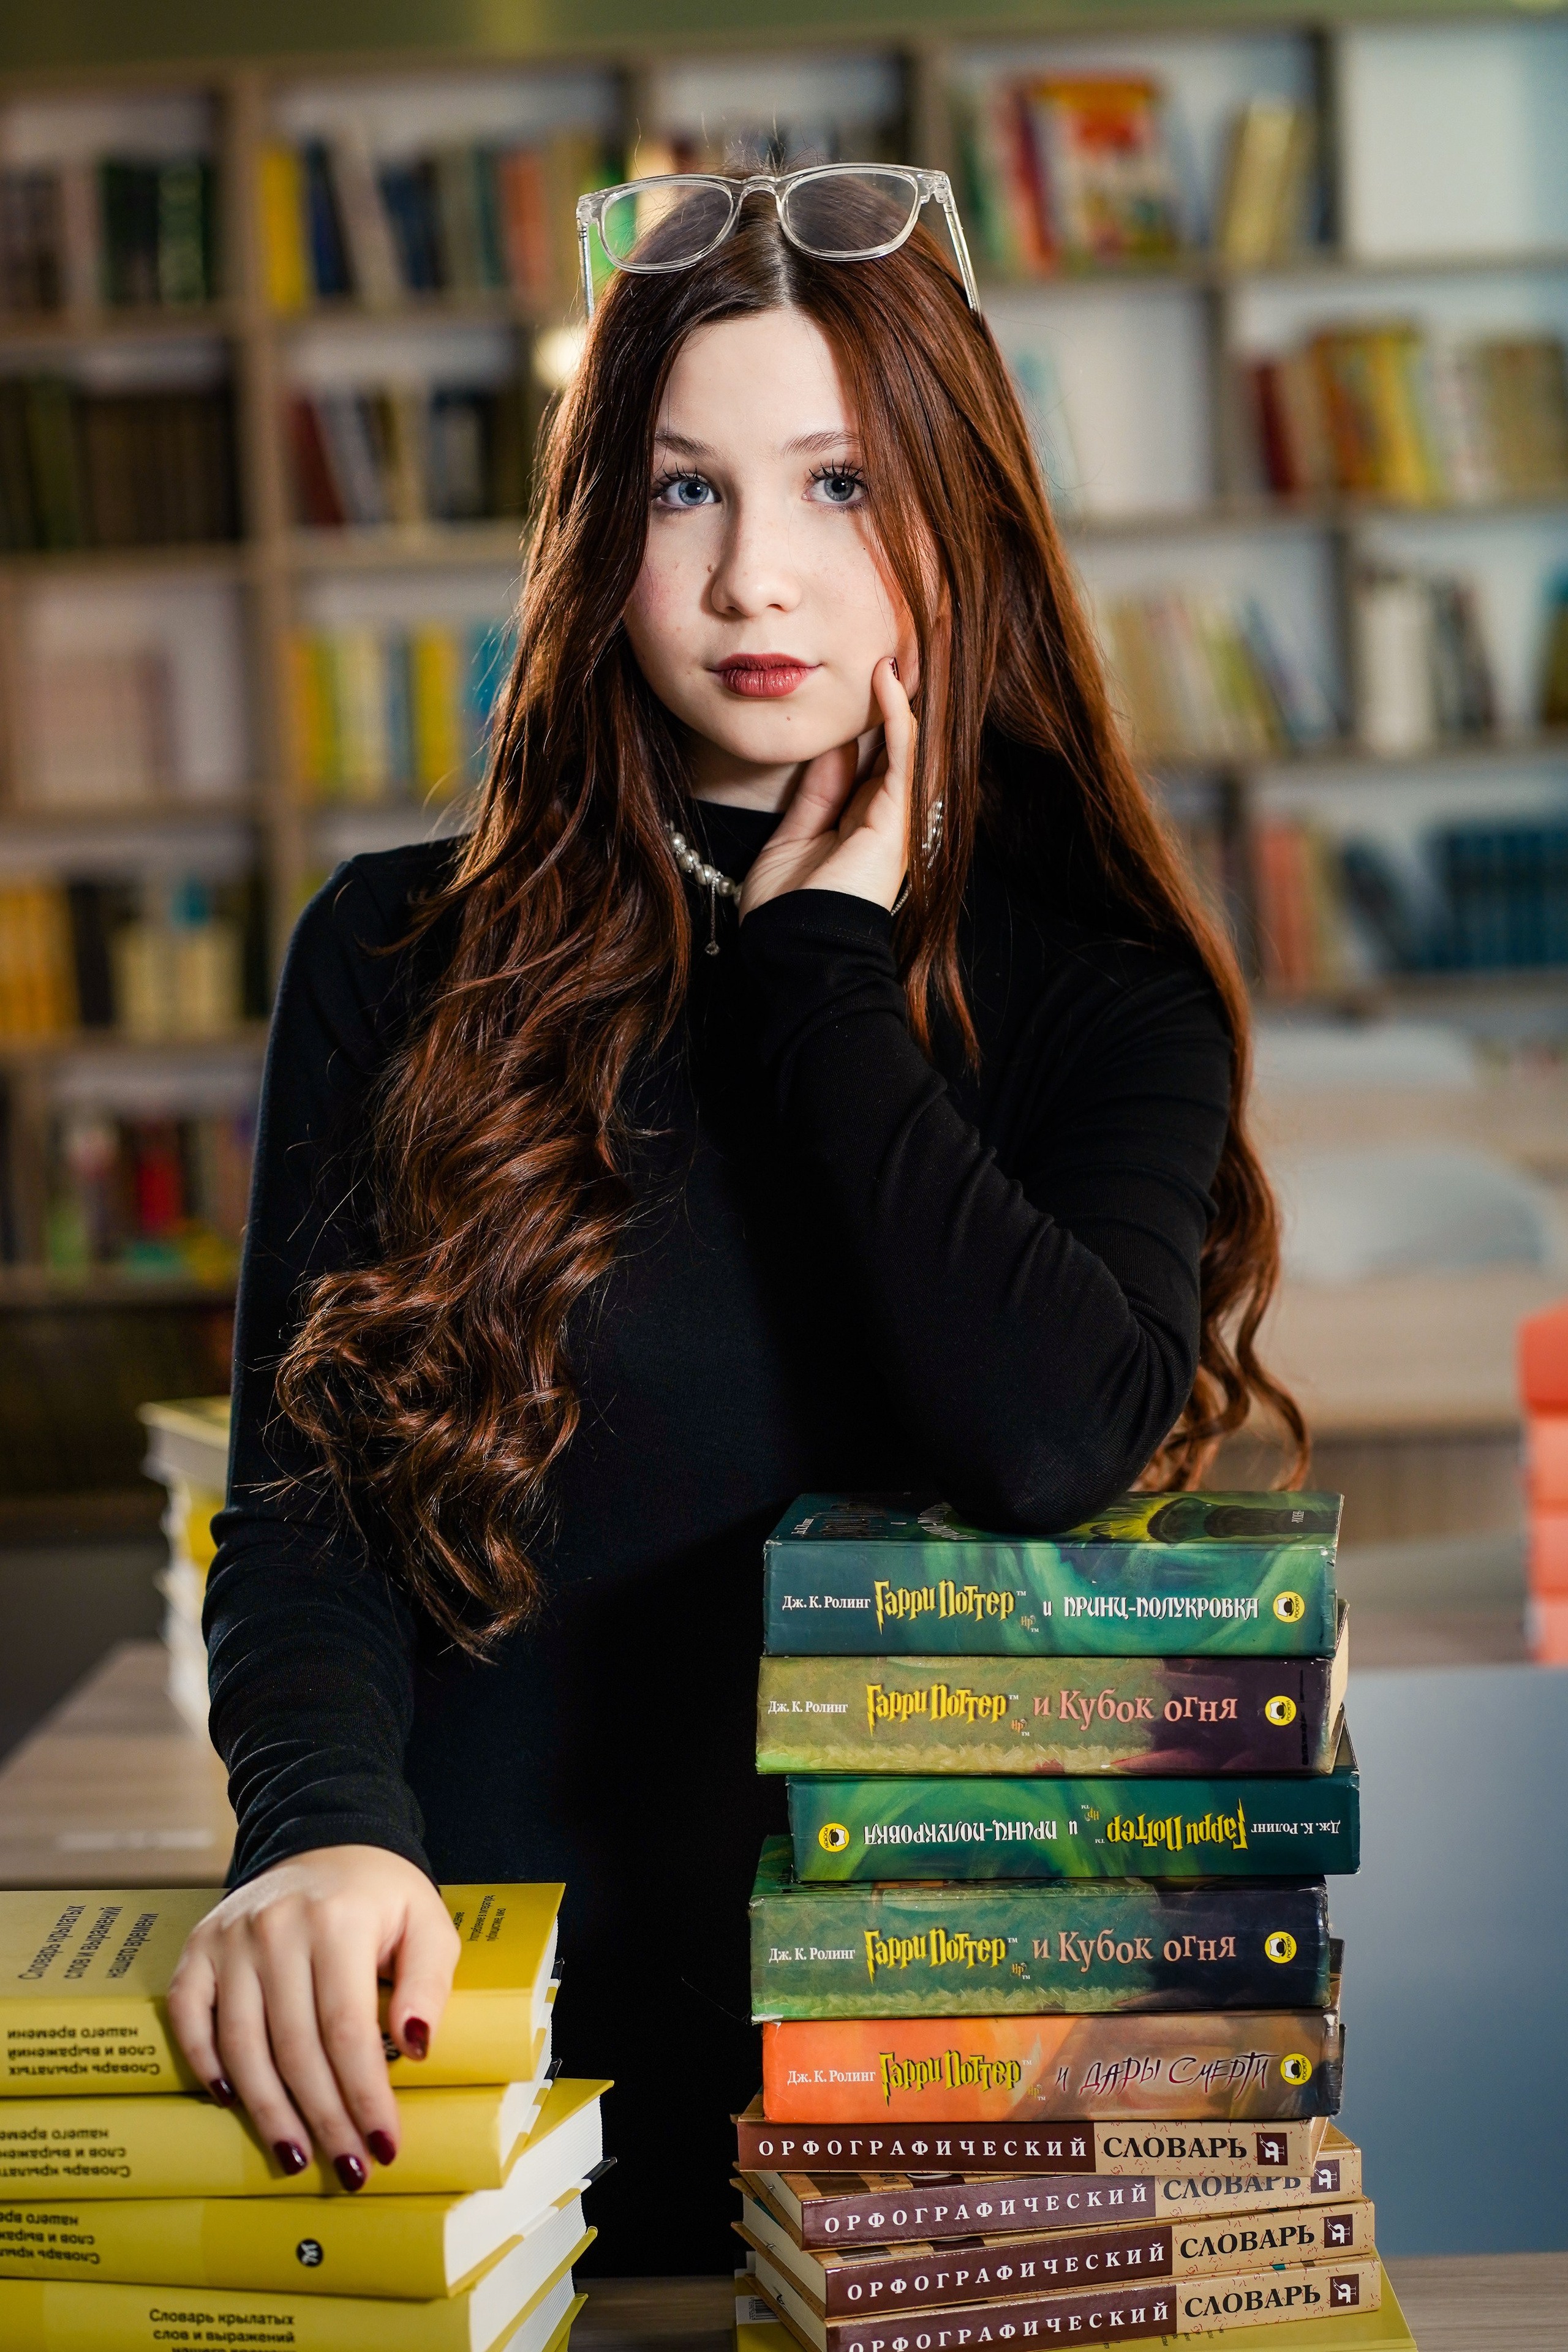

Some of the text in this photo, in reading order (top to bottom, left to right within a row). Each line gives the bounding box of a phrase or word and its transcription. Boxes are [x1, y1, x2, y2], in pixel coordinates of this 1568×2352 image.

[782, 1596, 806, 1610] Дж.
[809, 1596, 821, 1608] К.
[824, 1596, 871, 1609] Ролинг
[873, 1580, 936, 1635] Гарри
[1042, 1600, 1053, 1617] и
[1063, 1596, 1259, 1621] ПРИНЦ-ПОЛУКРОВКА
[767, 1701, 790, 1714] Дж.
[792, 1701, 803, 1713] К.
[805, 1701, 848, 1713] Ролинг
[866, 1683, 929, 1737] Гарри
[1033, 1697, 1050, 1716] и
[1058, 1688, 1155, 1731] Кубок
[1164, 1696, 1238, 1722] огня
[863, 1819, 1058, 1845] ПРИНЦ-ПОЛУКРОВКА
[1068, 1820, 1078, 1835] и
[1186, 1798, 1248, 1850] Гарри
[1251, 1823, 1298, 1834] Ролинг
[1300, 1822, 1314, 1834] К.
[1316, 1820, 1341, 1834] Дж.
[18, 1905, 86, 1979] Словарь крылатых
[64, 1958, 91, 1979] слов
[80, 1906, 123, 1950] выражений
[105, 1913, 159, 1978] нашего времени
[769, 1948, 792, 1963] Дж.
[794, 1948, 807, 1960] К.
[809, 1947, 856, 1961] Ролинг
[864, 1929, 927, 1985] Гарри
[1031, 1939, 1051, 1959] и
[1058, 1928, 1153, 1973] Кубок
[1163, 1936, 1236, 1961] огня
[7, 2025, 138, 2039] нашего времени
[7, 2044, 156, 2060] слов и выражений
[9, 2061, 160, 2075] Словарь крылатых
[787, 2071, 812, 2086] Дж.
[813, 2070, 827, 2082] К.
[829, 2070, 876, 2082] Ролинг
[878, 2051, 943, 2108] Гарри
[51, 2128, 109, 2139] нашего
[89, 2147, 126, 2157] слов
[759, 2136, 1248, 2158] ОРФОГРАФИЧЕСКИЙ СЛОВАРЬ
[0, 2163, 131, 2177] Словарь крылат
[824, 2176, 1301, 2233] ОРФОГРАФИЧЕСКИЙ СЛОВАРЬ
[26, 2214, 78, 2225] нашего
[48, 2234, 56, 2242] и
[60, 2234, 94, 2245] слов
[37, 2248, 100, 2264] Словарь
[847, 2224, 1315, 2301] ОРФОГРАФИЧЕСКИЙ СЛОВАРЬ
[149, 2309, 295, 2327] Словарь крылатых
[849, 2302, 1169, 2352] ОРФОГРАФИЧЕСКИЙ
[1184, 2284, 1321, 2318] СЛОВАРЬ
[153, 2330, 295, 2343] слов и выражений
